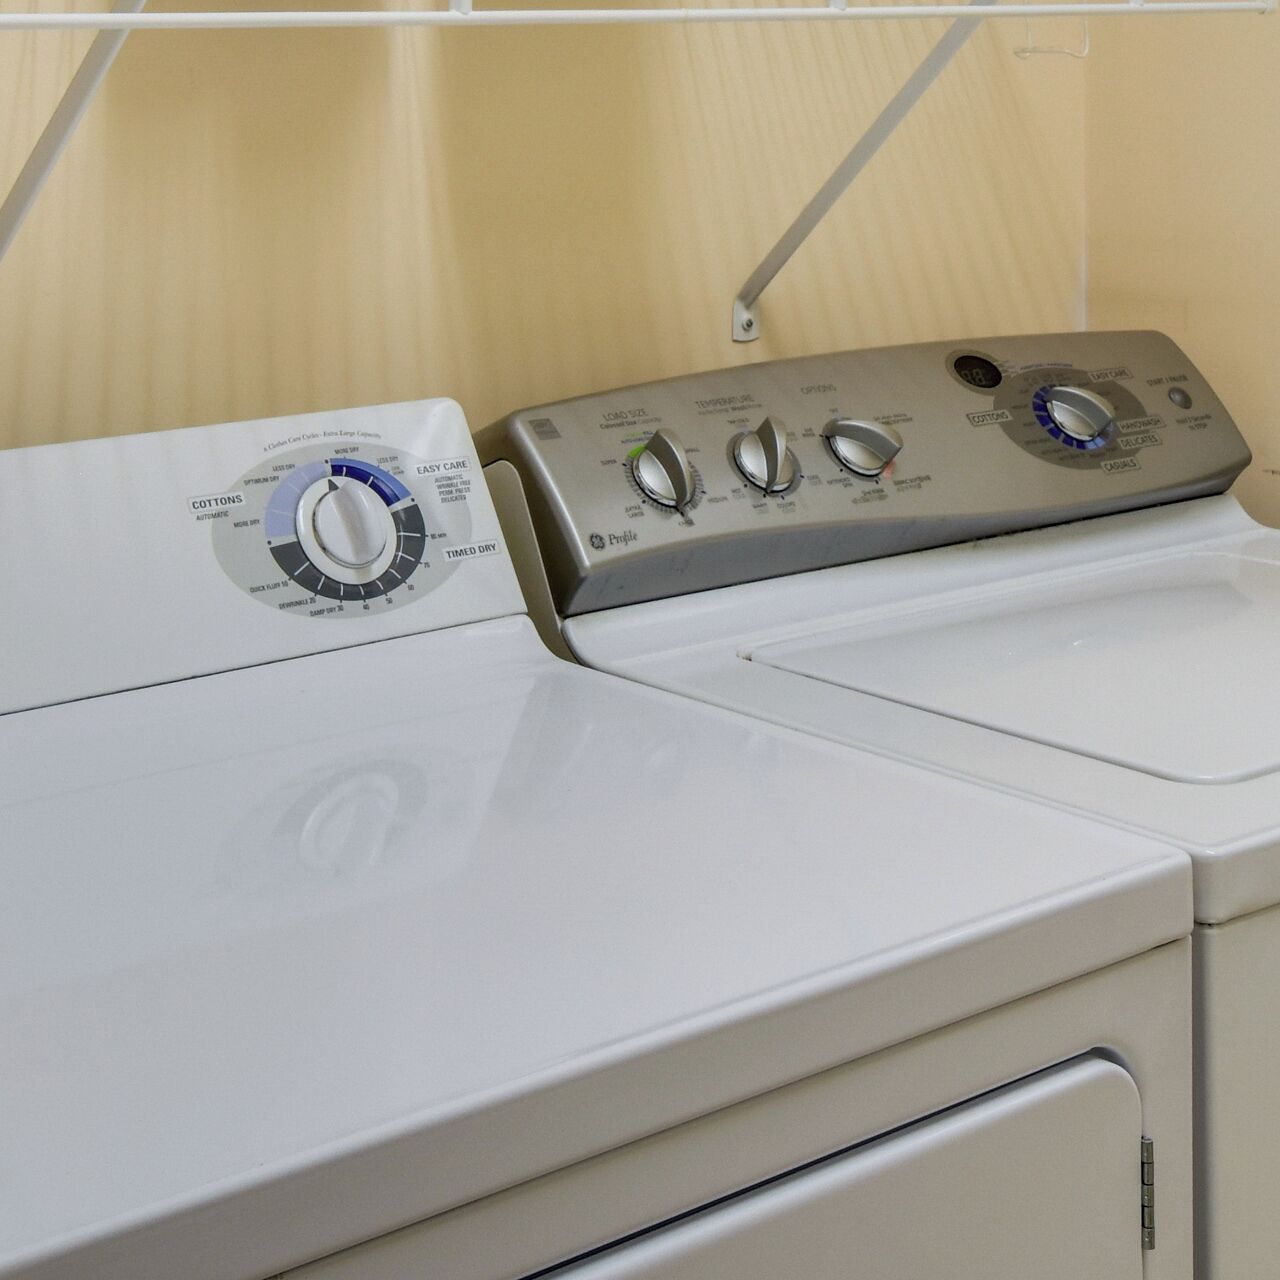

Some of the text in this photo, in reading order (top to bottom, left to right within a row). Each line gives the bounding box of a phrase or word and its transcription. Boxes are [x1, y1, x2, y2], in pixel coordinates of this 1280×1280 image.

[694, 394, 755, 408] TEMPERATURE
[601, 408, 649, 422] LOAD SIZE
[972, 411, 1009, 424] COTTONS
[1120, 434, 1158, 448] DELICATES
[417, 464, 440, 475] EASY
[443, 460, 468, 471] CARE
[1104, 459, 1137, 472] CASUALS
[243, 475, 280, 486] OPTIMUM DRY
[434, 474, 463, 483] AUTOMATIC
[192, 495, 243, 510] COTTONS
[196, 510, 229, 521] AUTOMATIC
[233, 520, 249, 528] MORE
[608, 529, 638, 547] Profile
[445, 543, 496, 559] TIMED DRY
[250, 585, 266, 593] QUICK
[278, 596, 316, 610] DEWRINKLE 20
